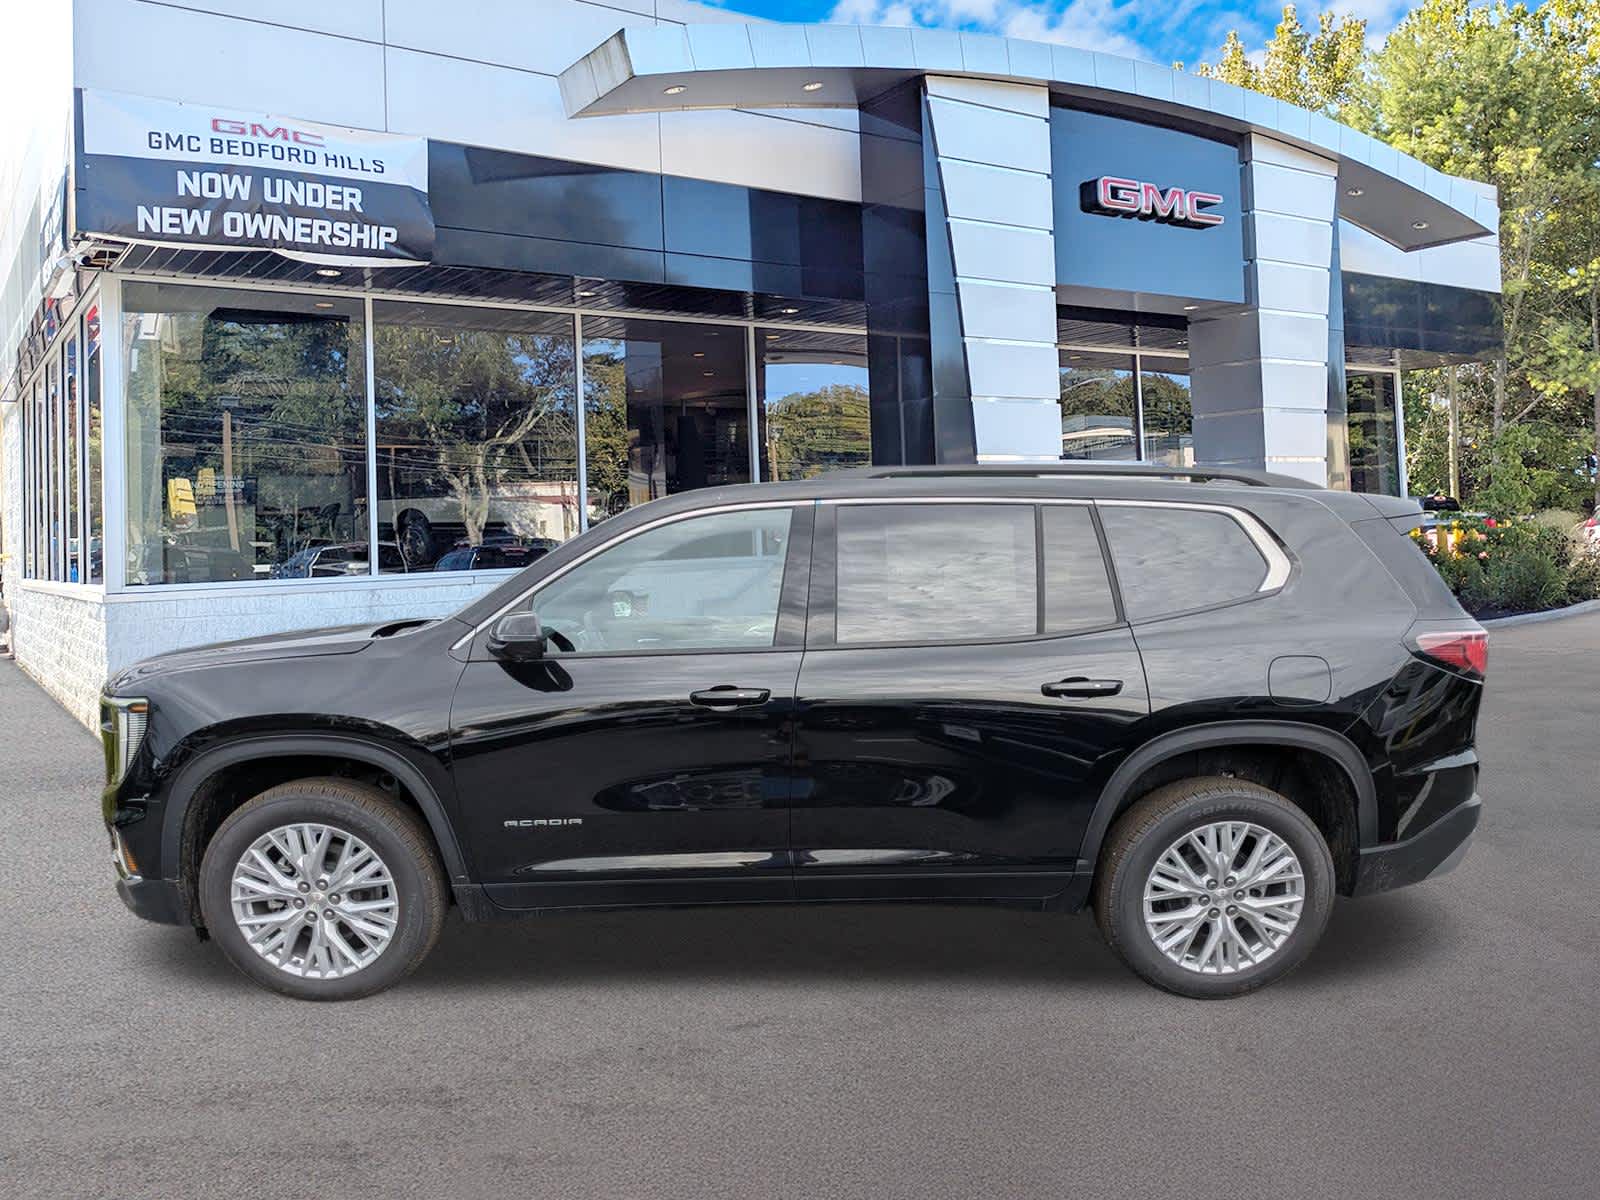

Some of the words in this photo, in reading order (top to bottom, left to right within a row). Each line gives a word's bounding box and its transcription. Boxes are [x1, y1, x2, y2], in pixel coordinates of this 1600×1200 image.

[147, 131, 201, 152] GMC
[209, 137, 317, 165] BEDFORD
[324, 152, 385, 174] HILLS
[210, 118, 326, 148] GMC
[176, 170, 252, 201] NOW
[263, 176, 364, 213] UNDER
[1097, 175, 1225, 225] GMC
[136, 205, 212, 236] NEW
[223, 211, 398, 251] OWNERSHIP
[503, 818, 583, 828] ACADIA
